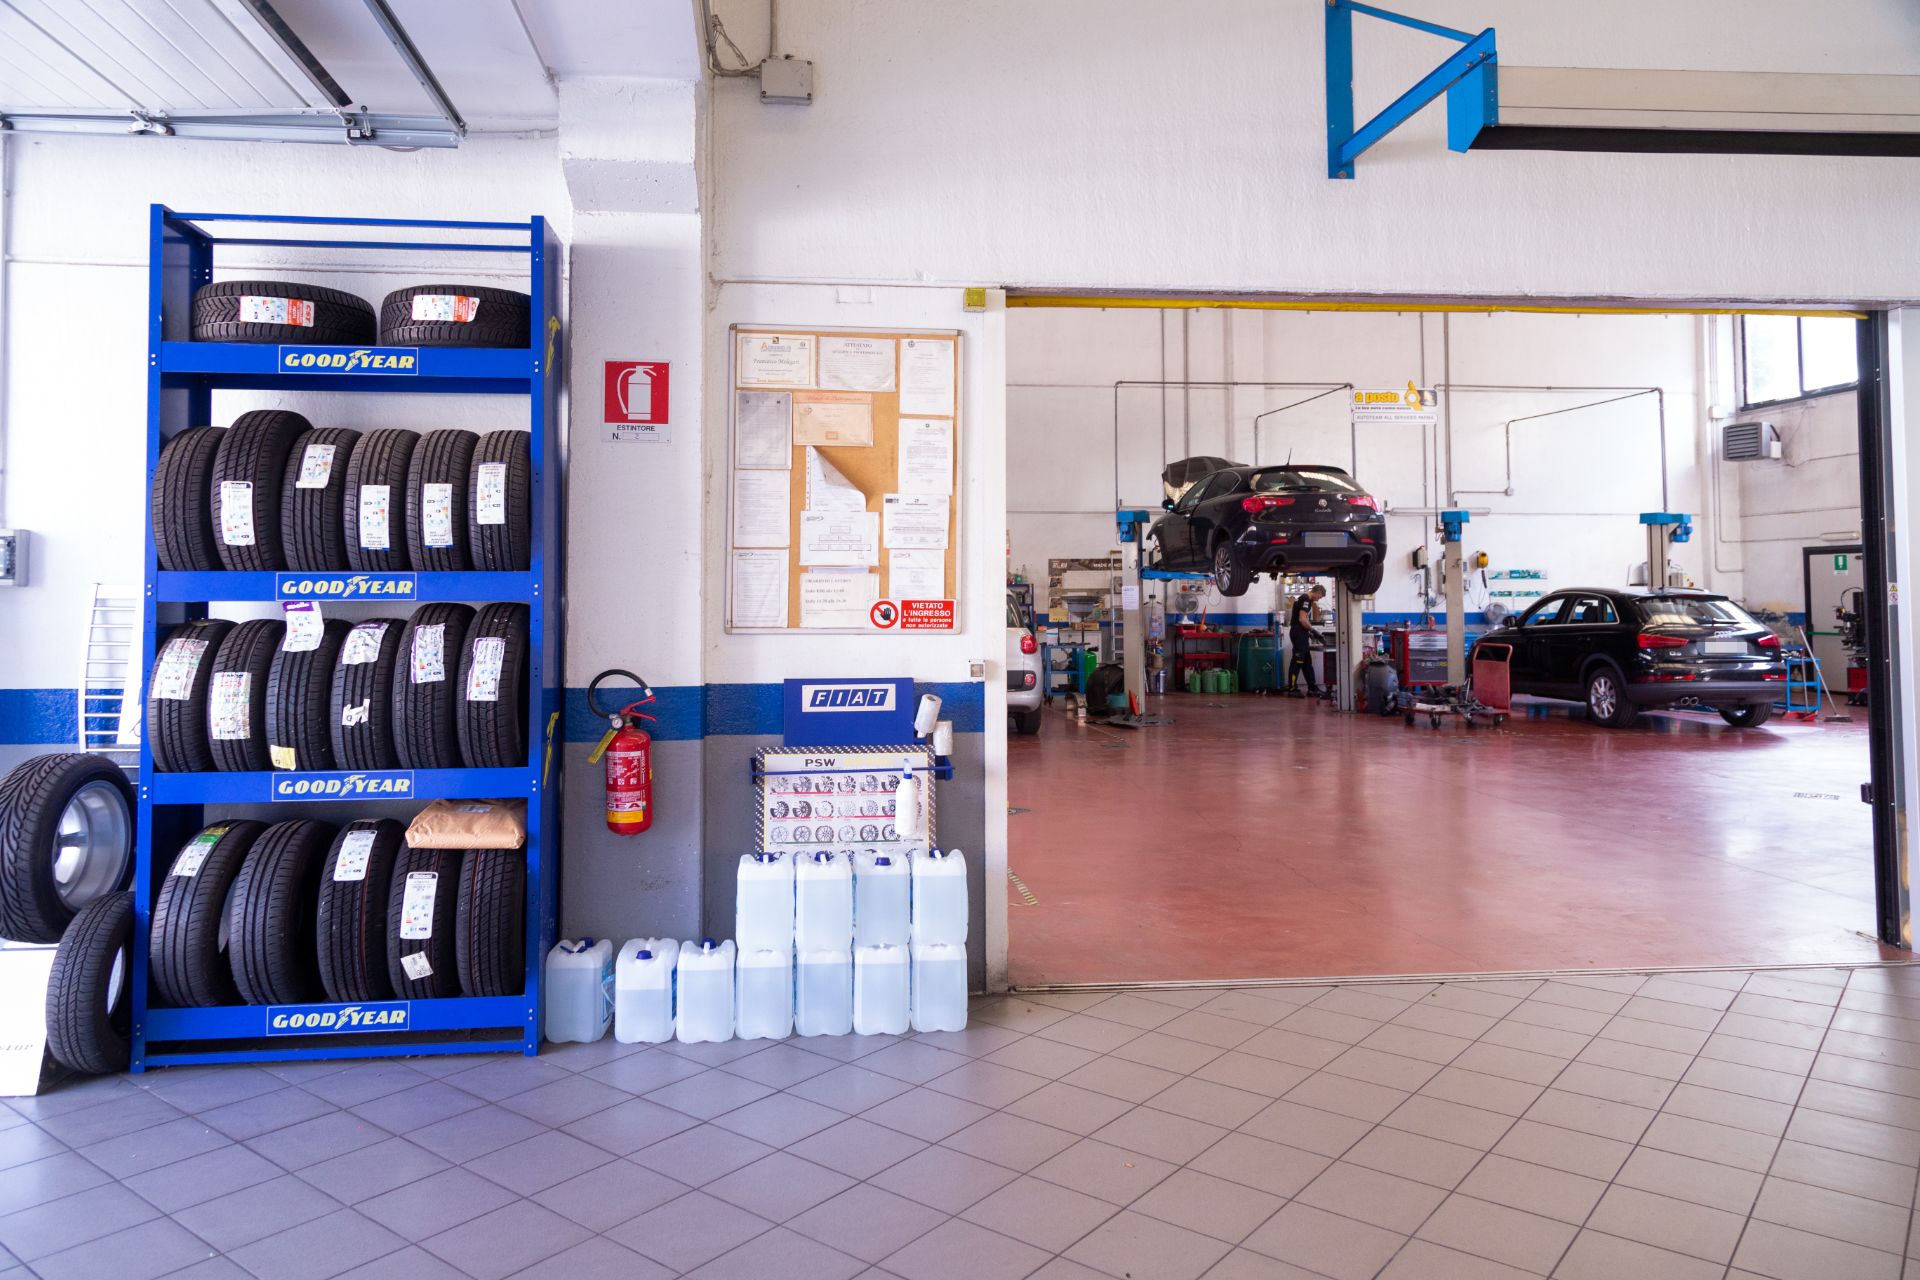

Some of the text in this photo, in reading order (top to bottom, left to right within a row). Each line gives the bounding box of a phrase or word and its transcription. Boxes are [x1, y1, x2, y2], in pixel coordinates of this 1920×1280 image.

[1354, 392, 1399, 404] a posto
[612, 432, 621, 441] N.
[814, 690, 885, 706] FIAT
[804, 758, 836, 768] PSW
[607, 801, 641, 810] CEA
